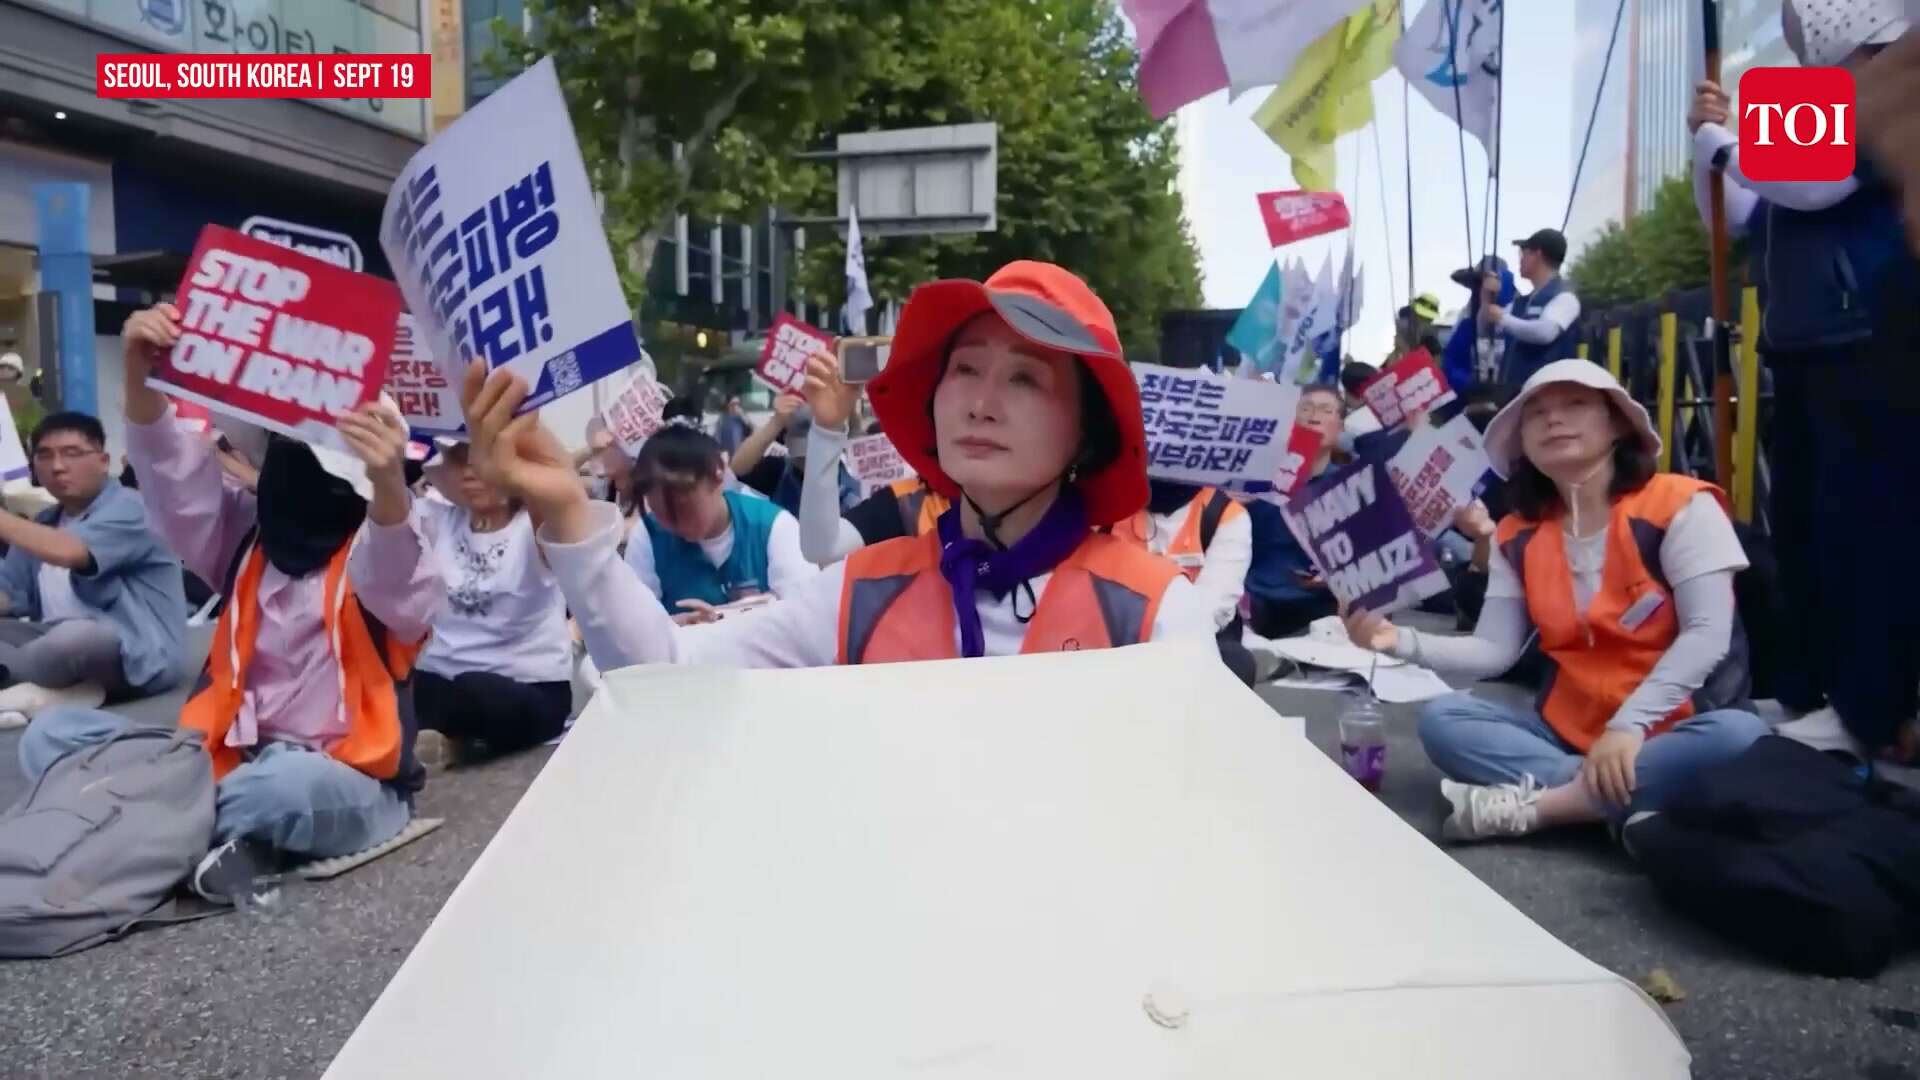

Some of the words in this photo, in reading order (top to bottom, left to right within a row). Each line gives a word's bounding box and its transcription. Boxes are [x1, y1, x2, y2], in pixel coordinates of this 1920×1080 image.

[191, 248, 311, 308] STOP
[170, 332, 244, 385] ON
[181, 288, 272, 346] THE
[268, 311, 376, 378] WAR
[1142, 373, 1226, 410] 정부는
[1320, 531, 1354, 569] TO
